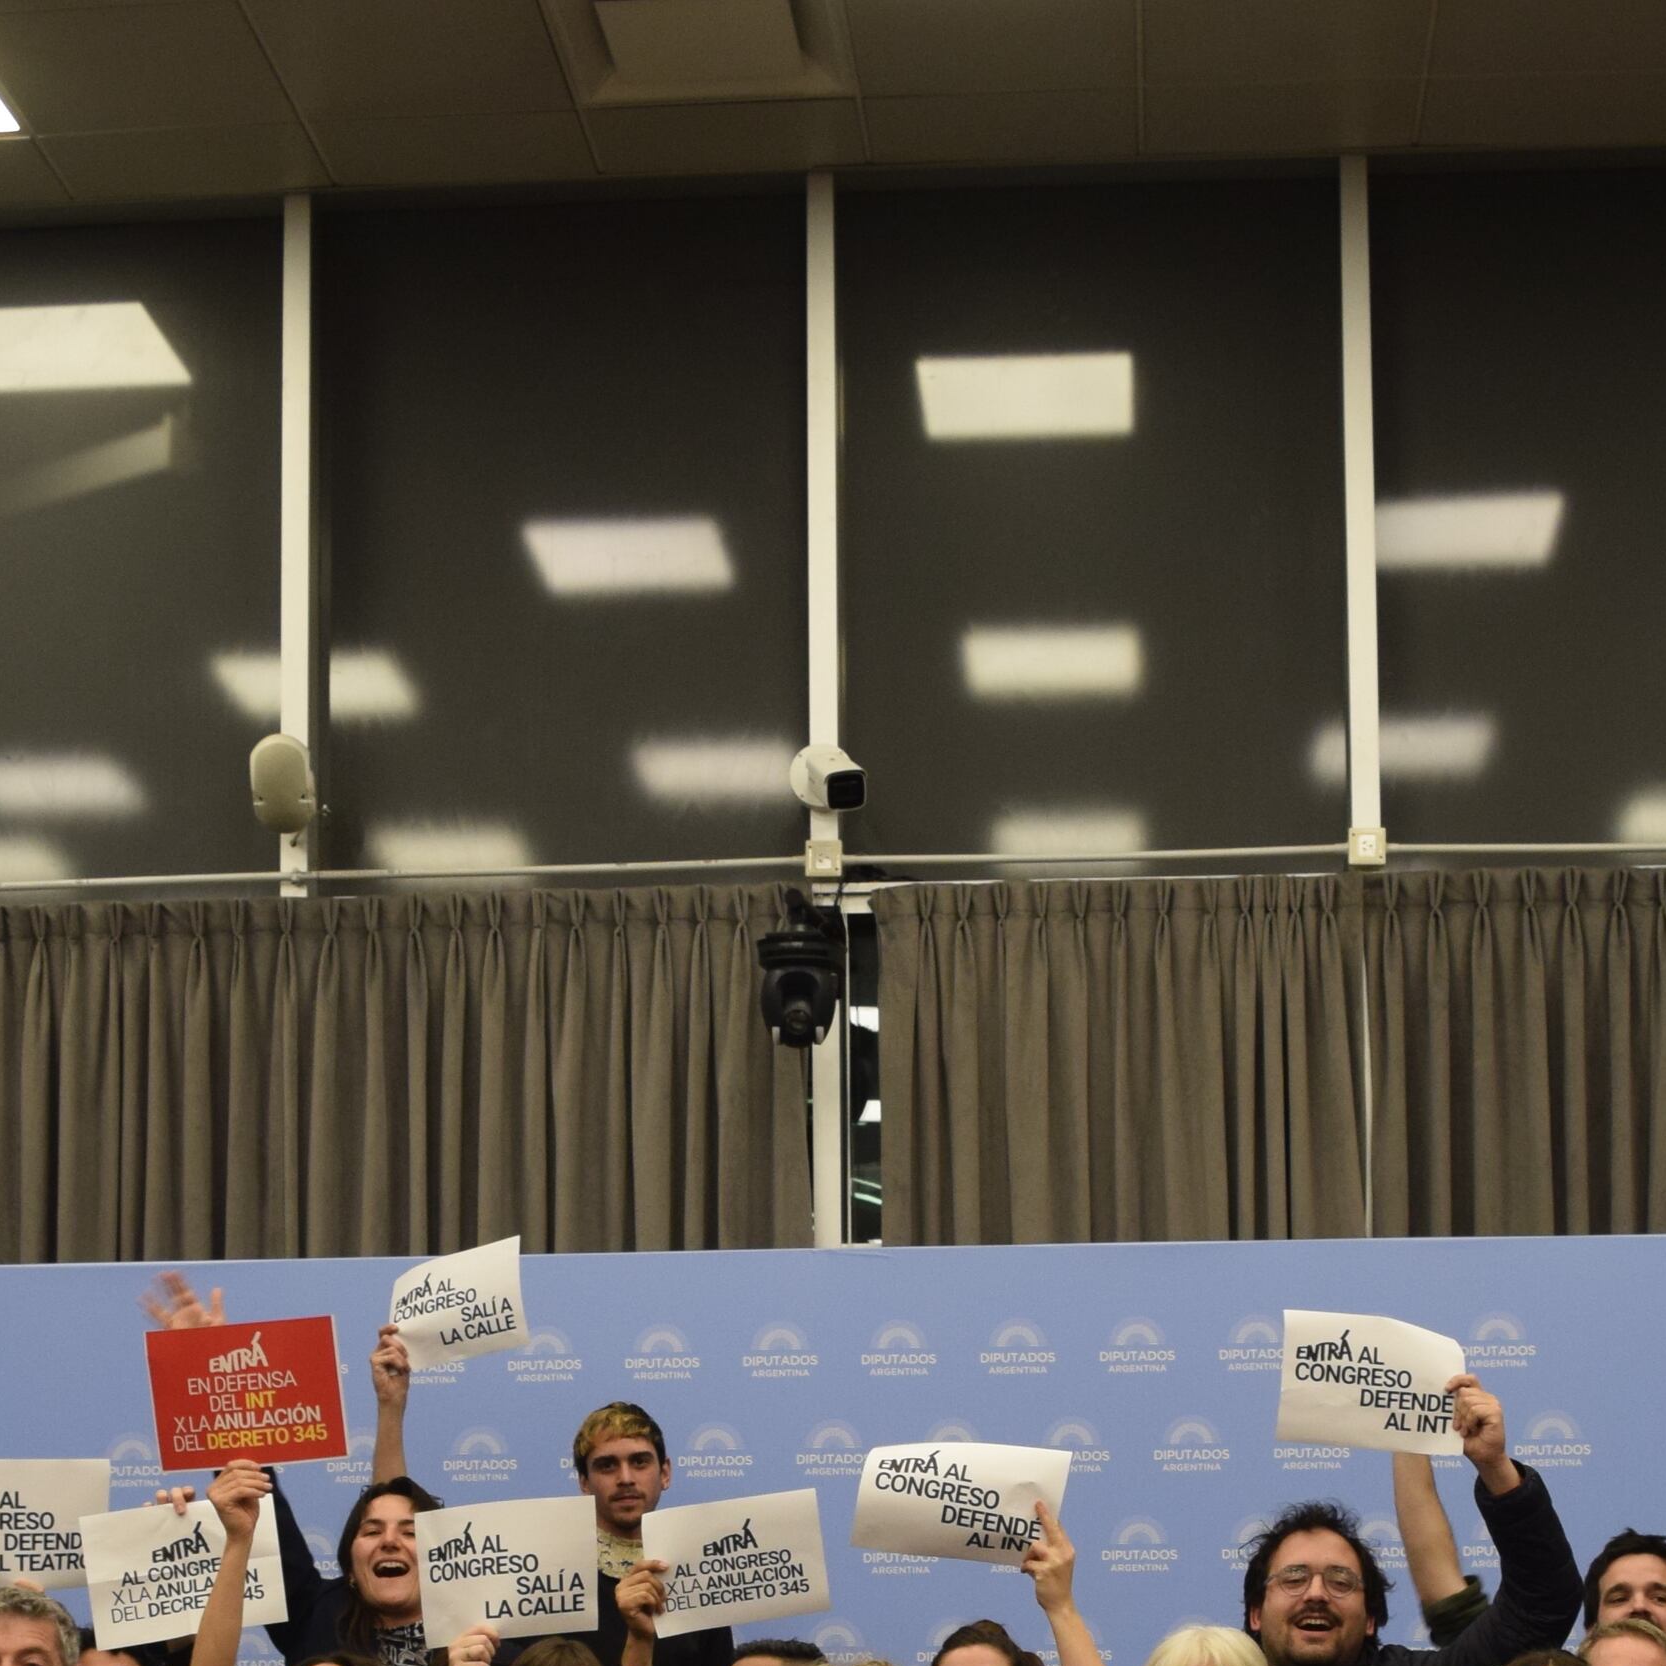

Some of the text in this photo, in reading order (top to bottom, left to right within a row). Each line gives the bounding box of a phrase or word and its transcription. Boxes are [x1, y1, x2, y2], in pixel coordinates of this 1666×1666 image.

[209, 1331, 269, 1373] ENTRÁ
[1099, 1350, 1175, 1362] DIPUTADOS
[1296, 1329, 1385, 1365] ENTRÁ AL
[743, 1355, 819, 1367] DIPUTADOS
[1108, 1364, 1167, 1372] ARGENTINA
[187, 1370, 297, 1395] EN DEFENSA
[751, 1369, 810, 1378] ARGENTINA
[1295, 1362, 1412, 1388] CONGRESO
[209, 1390, 275, 1412] DEL INT
[174, 1402, 321, 1433] X LA ANULACIÓN
[1384, 1412, 1453, 1434] AL INT
[173, 1424, 327, 1452] DEL DECRETO 345
